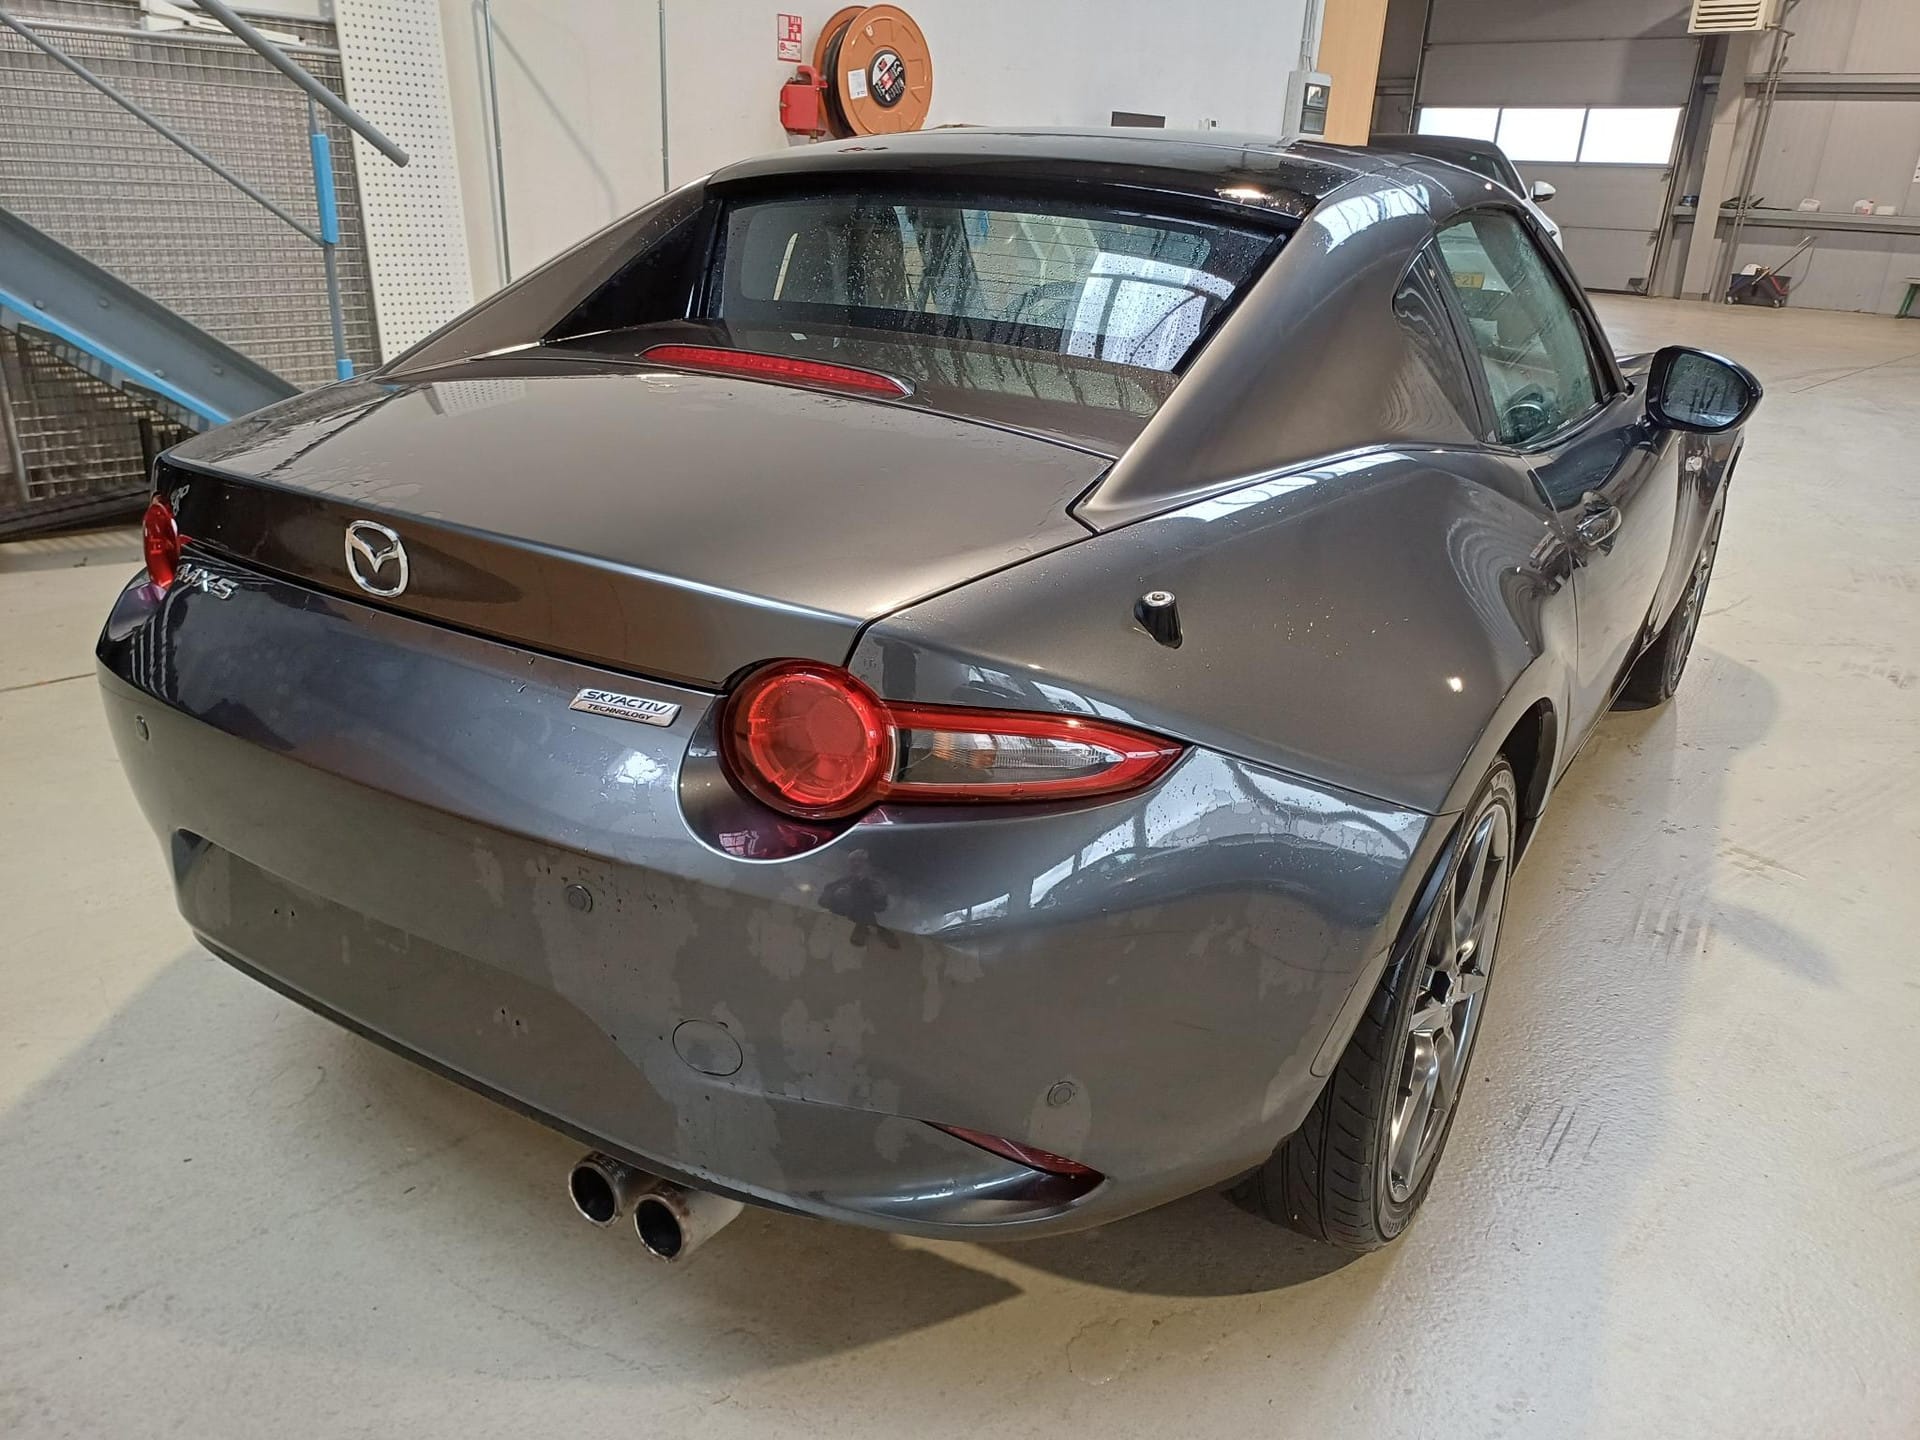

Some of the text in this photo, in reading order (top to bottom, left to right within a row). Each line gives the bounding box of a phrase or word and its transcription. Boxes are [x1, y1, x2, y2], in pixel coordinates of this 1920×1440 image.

[175, 563, 240, 600] MX-5
[583, 690, 668, 712] SKYACTIV
[587, 703, 654, 721] TECHNOLOGY
